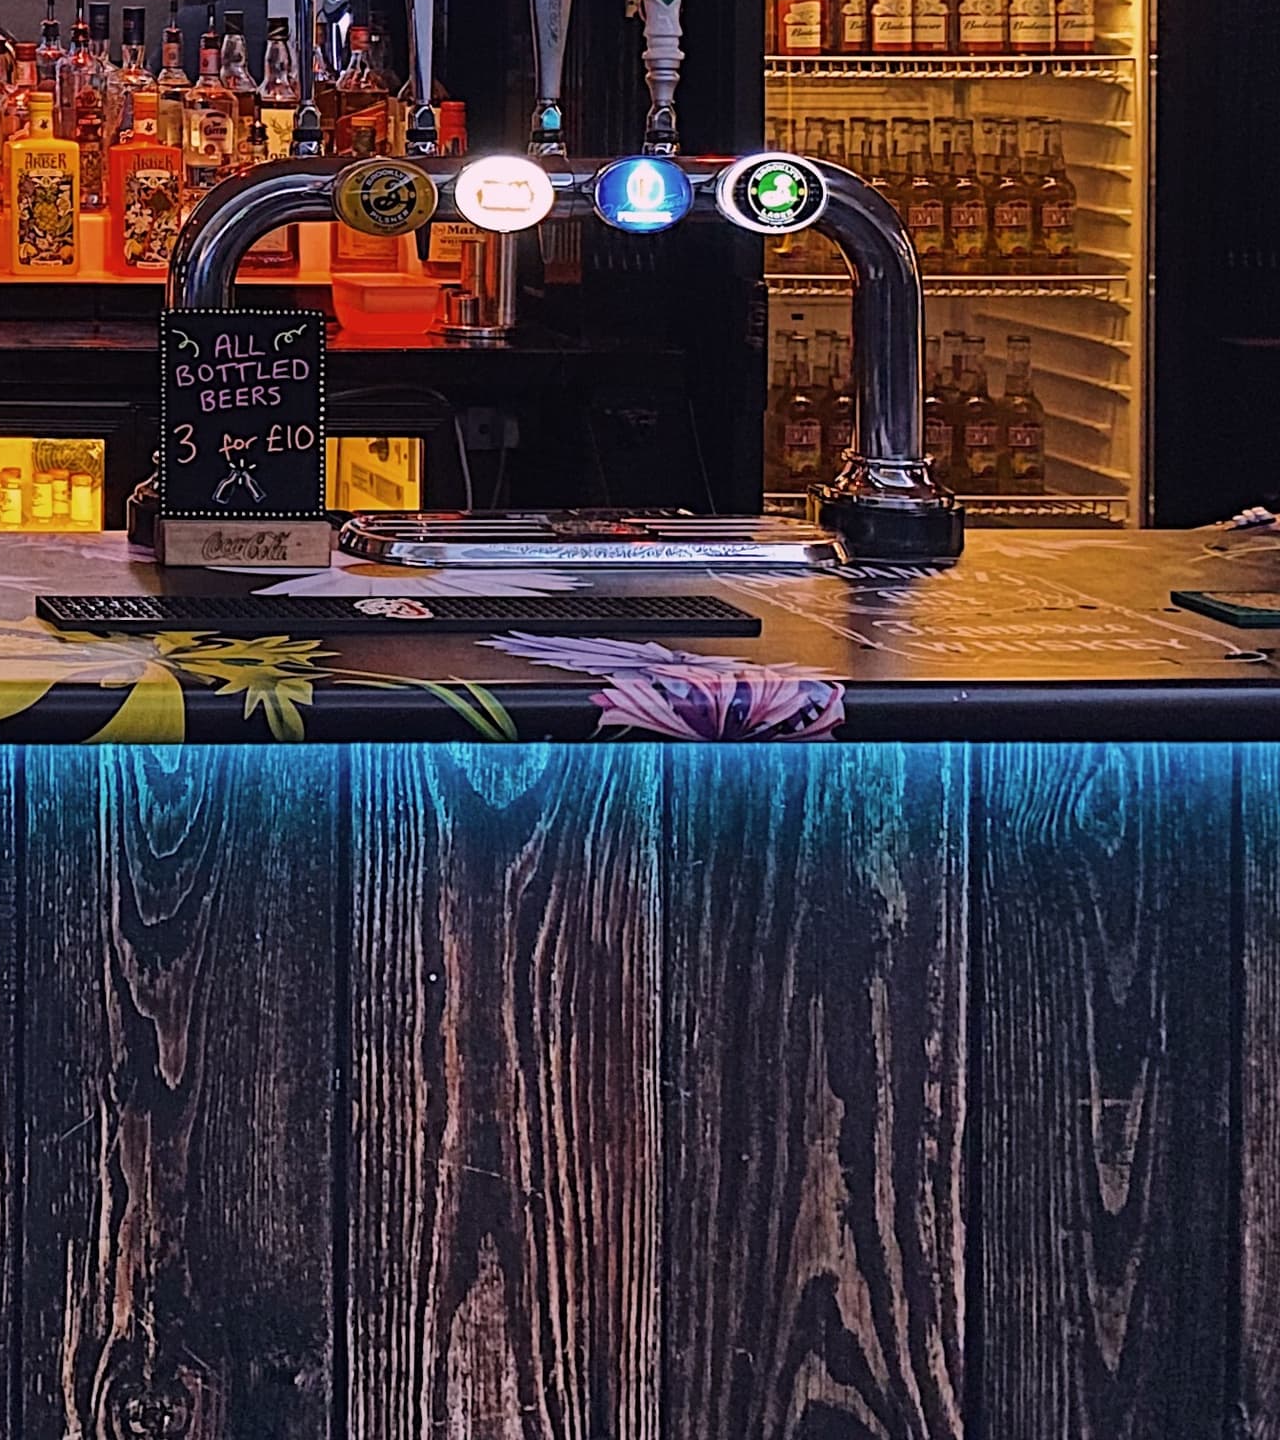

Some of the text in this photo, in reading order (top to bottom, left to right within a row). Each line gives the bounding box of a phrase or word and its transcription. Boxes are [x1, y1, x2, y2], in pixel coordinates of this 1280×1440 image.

[24, 152, 68, 170] ARBER
[214, 333, 267, 359] ALL
[175, 359, 310, 388] BOTTLED
[200, 386, 282, 413] BEERS
[173, 424, 315, 464] 3 for £10
[908, 637, 1200, 655] WHISKEY
